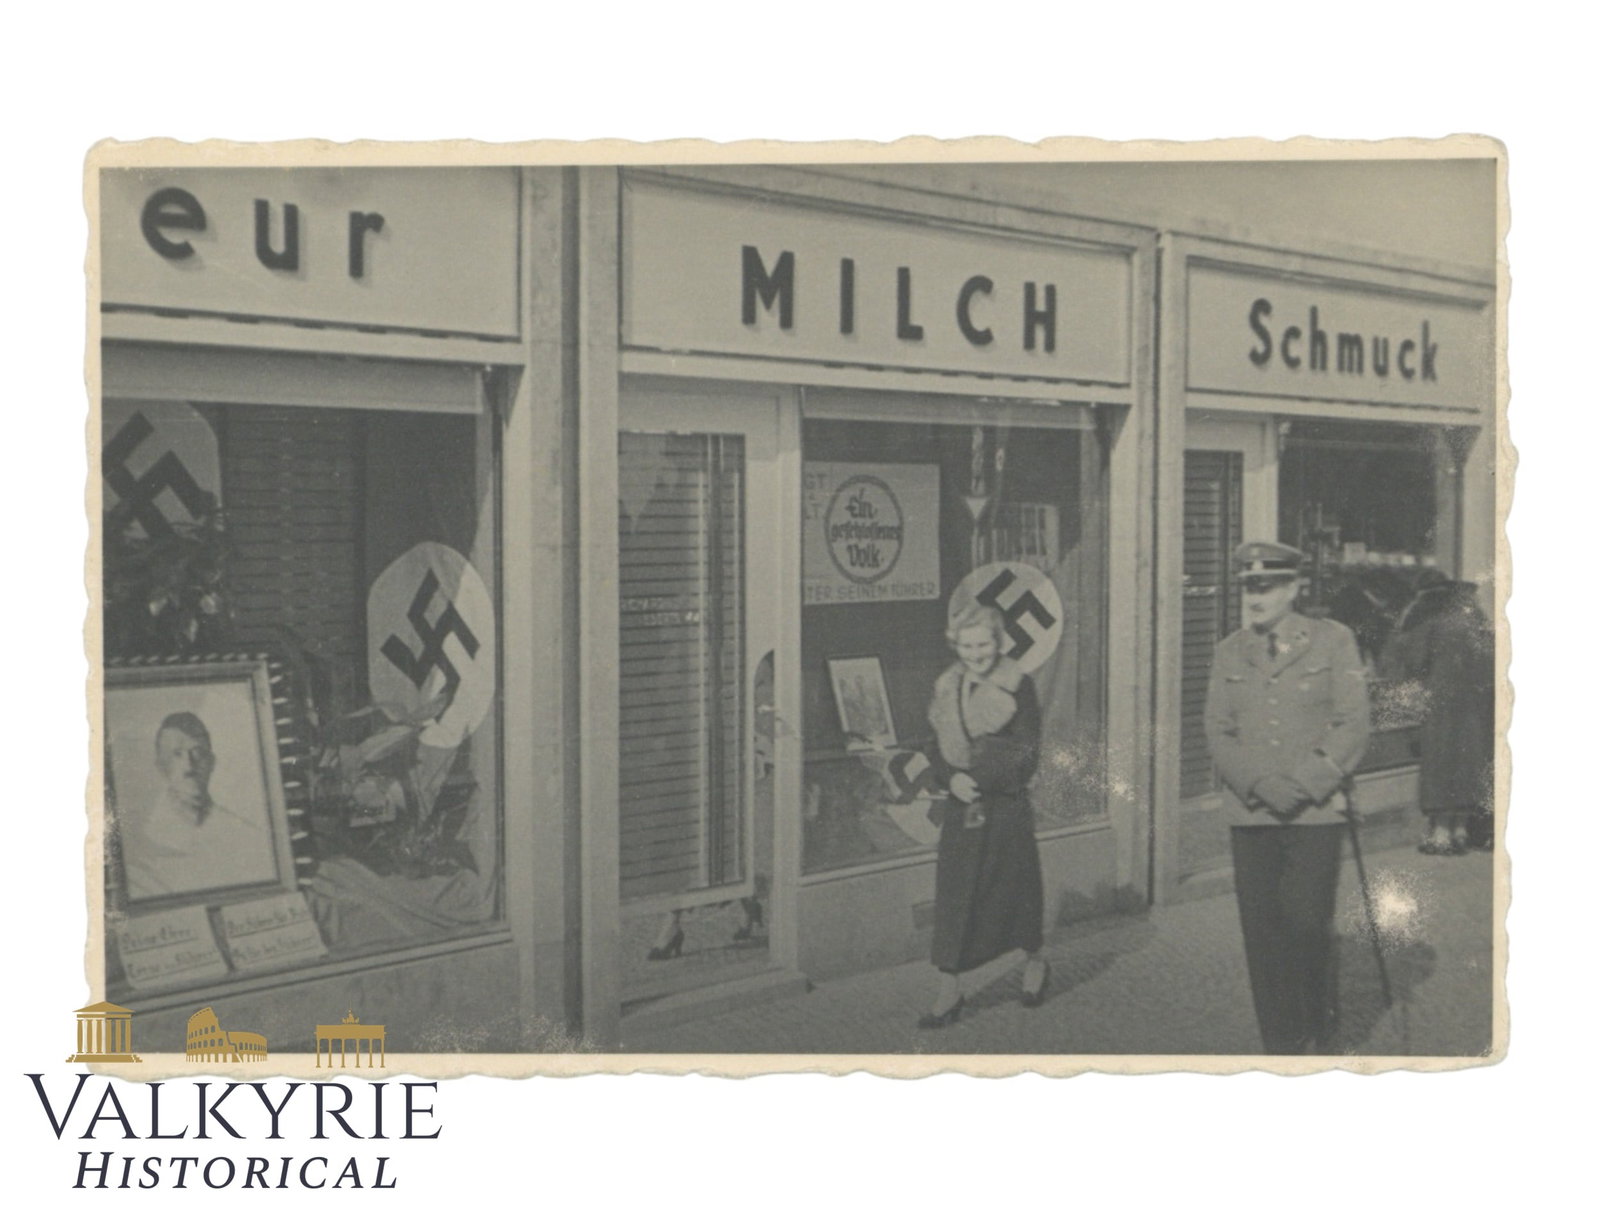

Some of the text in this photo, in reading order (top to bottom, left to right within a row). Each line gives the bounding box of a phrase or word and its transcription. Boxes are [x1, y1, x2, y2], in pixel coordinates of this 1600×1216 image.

[141, 186, 385, 279] eur
[741, 245, 1057, 353] MILCH
[1248, 298, 1439, 382] Schmuck
[838, 584, 887, 600] SEINEM
[891, 582, 936, 598] FÜHRER
